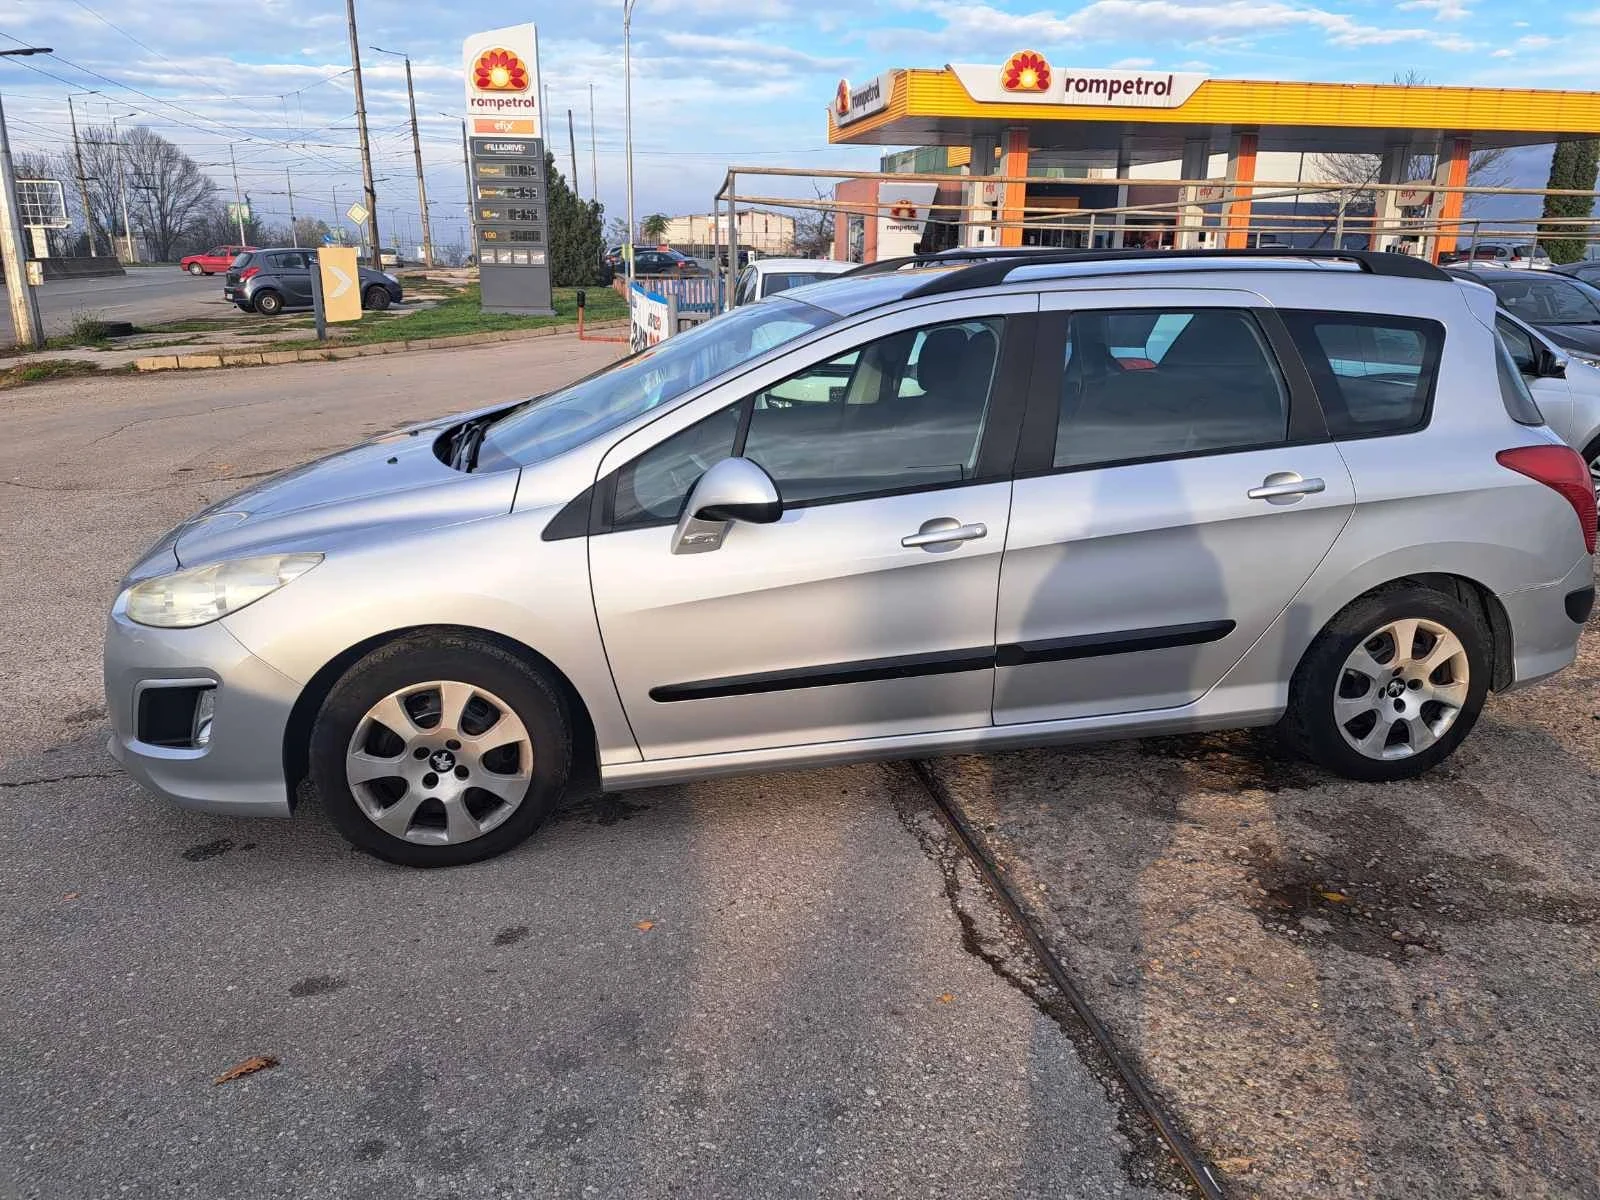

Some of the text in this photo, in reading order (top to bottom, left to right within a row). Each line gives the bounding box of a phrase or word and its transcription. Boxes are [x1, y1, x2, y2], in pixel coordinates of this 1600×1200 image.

[852, 75, 880, 112] rompetrol
[1064, 75, 1173, 101] rompetrol
[470, 95, 535, 111] rompetrol
[494, 121, 514, 133] efix
[886, 224, 919, 232] rompetrol
